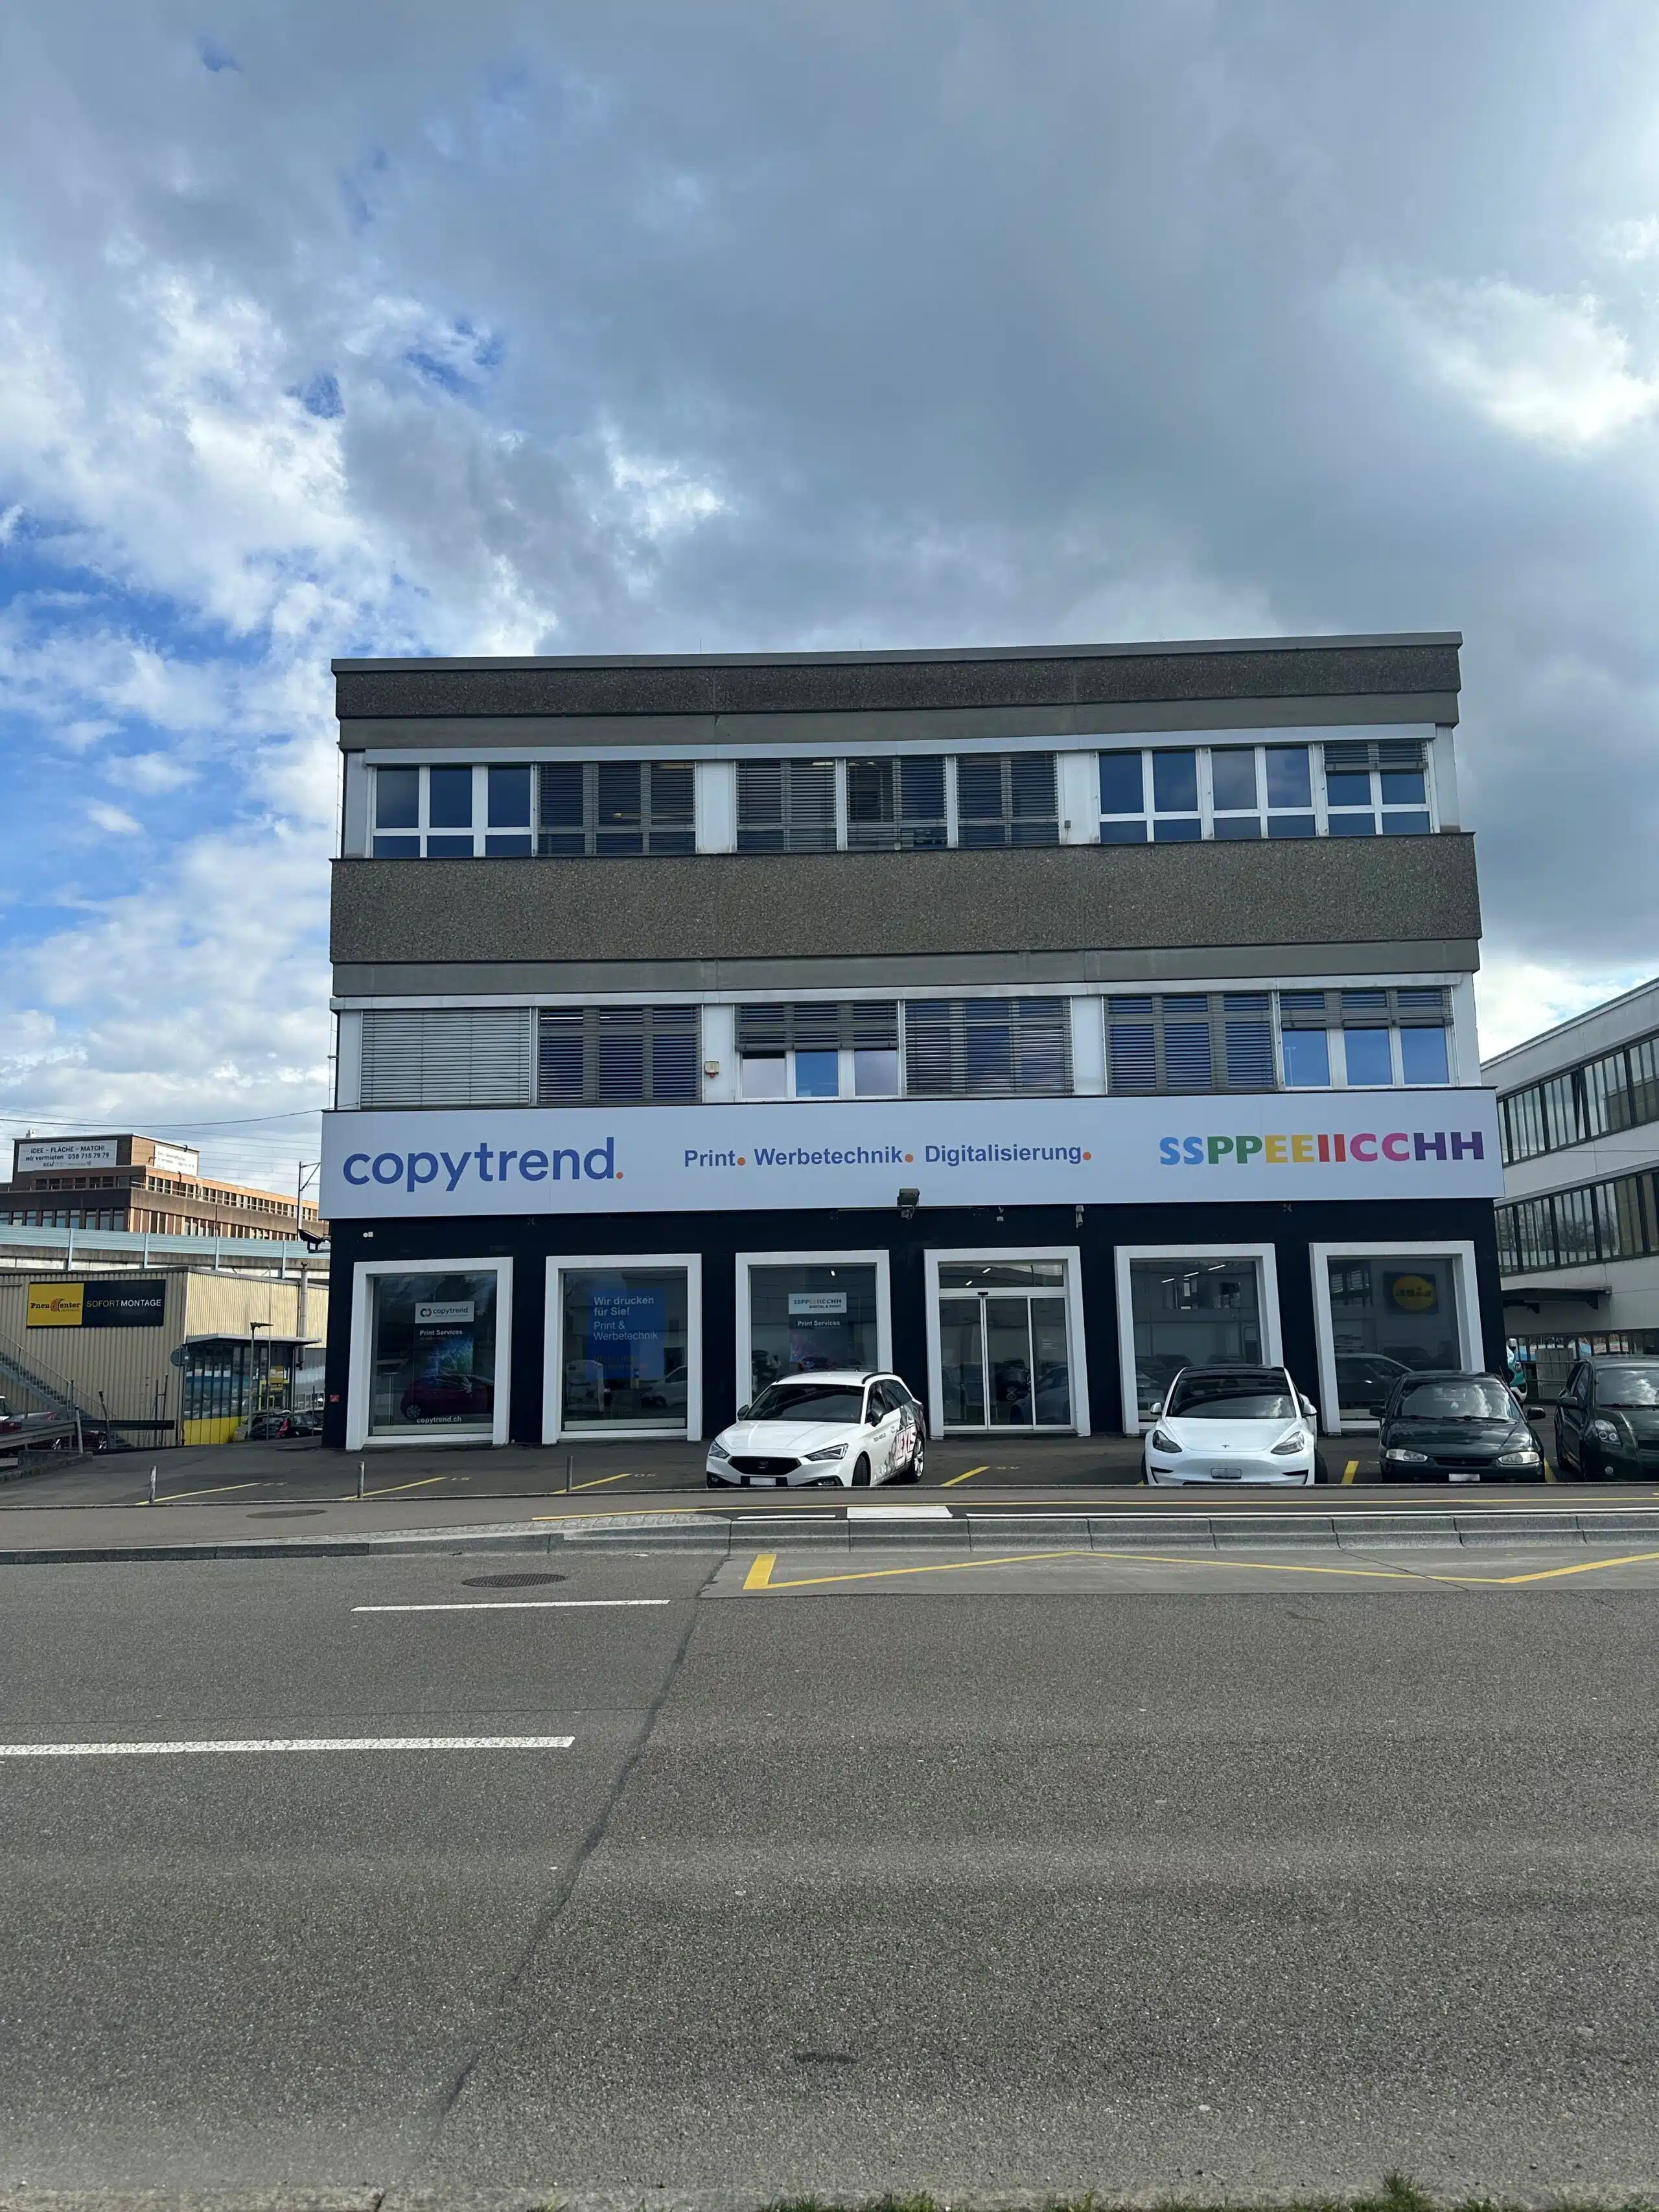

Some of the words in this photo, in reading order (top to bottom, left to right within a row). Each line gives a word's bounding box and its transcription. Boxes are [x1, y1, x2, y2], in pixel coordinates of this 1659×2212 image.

[1159, 1131, 1485, 1166] SSPPEEIICCHH
[754, 1146, 914, 1165] Werbetechnik.
[925, 1144, 1092, 1167] Digitalisierung.
[343, 1137, 623, 1192] copytrend.
[594, 1297, 610, 1305] Wir
[614, 1296, 655, 1305] drucken
[594, 1307, 609, 1316] für
[610, 1307, 630, 1316] Sie!
[594, 1321, 616, 1330] Print
[618, 1320, 626, 1329] &
[594, 1331, 658, 1340] Werbetechnik
[416, 1415, 462, 1424] copytrend.ch
